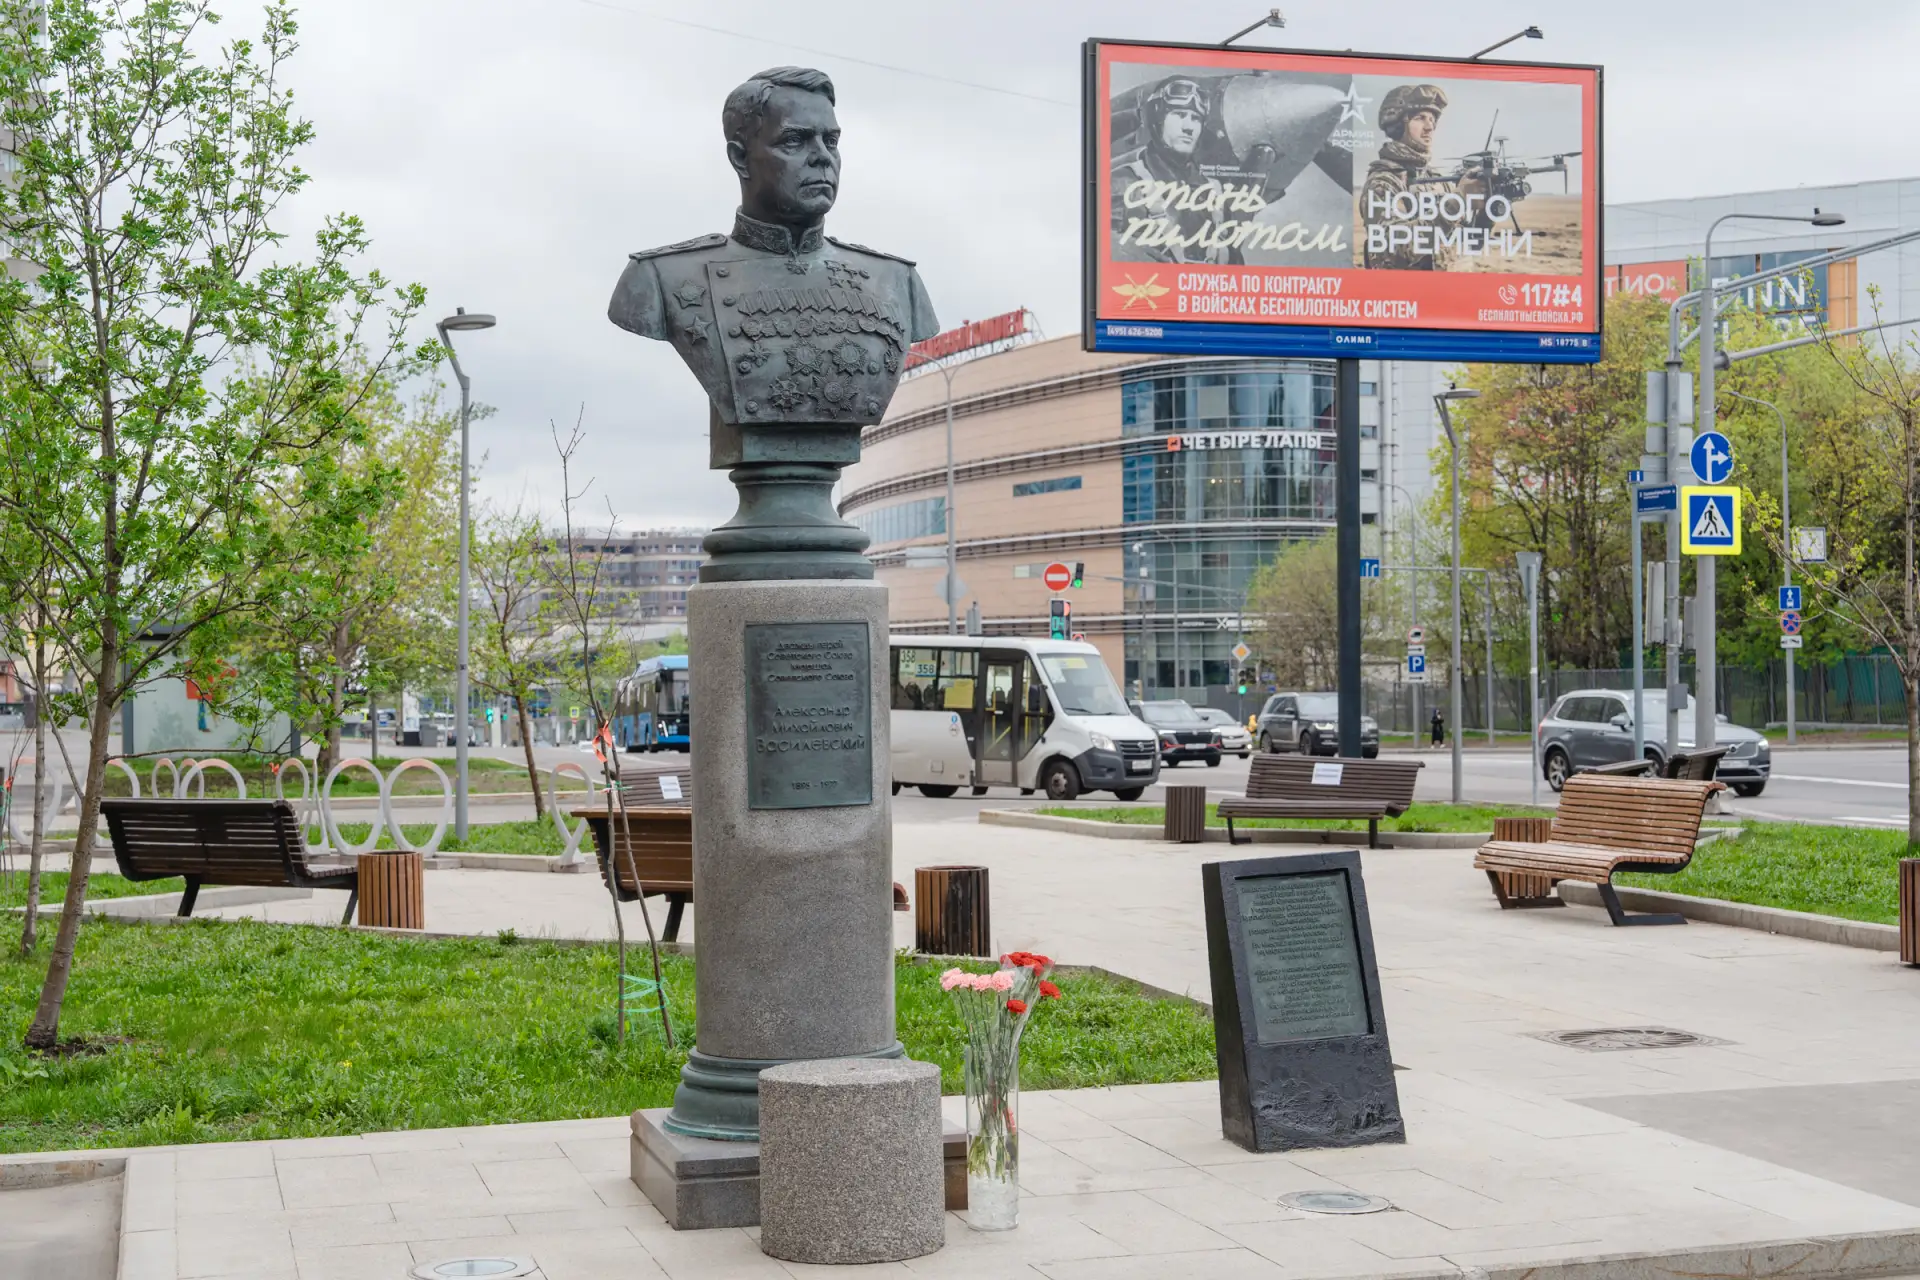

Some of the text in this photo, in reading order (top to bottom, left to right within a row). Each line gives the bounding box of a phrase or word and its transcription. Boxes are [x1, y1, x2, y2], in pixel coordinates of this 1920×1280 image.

[1124, 179, 1267, 213] стань
[1367, 189, 1511, 223] НОВОГО
[1119, 217, 1347, 253] пилотом
[1367, 224, 1532, 258] ВРЕМЕНИ
[1177, 273, 1342, 296] СЛУЖБА ПО КОНТРАКТУ
[1521, 283, 1583, 307] 117#4
[1712, 273, 1806, 310] FNN
[1177, 293, 1417, 319] В ВОЙСКАХ БЕСПИЛОТНЫХ СИСТЕМ
[1478, 309, 1583, 323] БЕСПИЛОТНЫЕВОЙСКА.РФ
[1335, 334, 1372, 344] ОЛИМП
[1540, 338, 1552, 346] MS
[1183, 433, 1321, 449] ЧЕТЫРЕ ЛАПЫ
[901, 650, 916, 663] 358
[917, 664, 935, 674] 358
